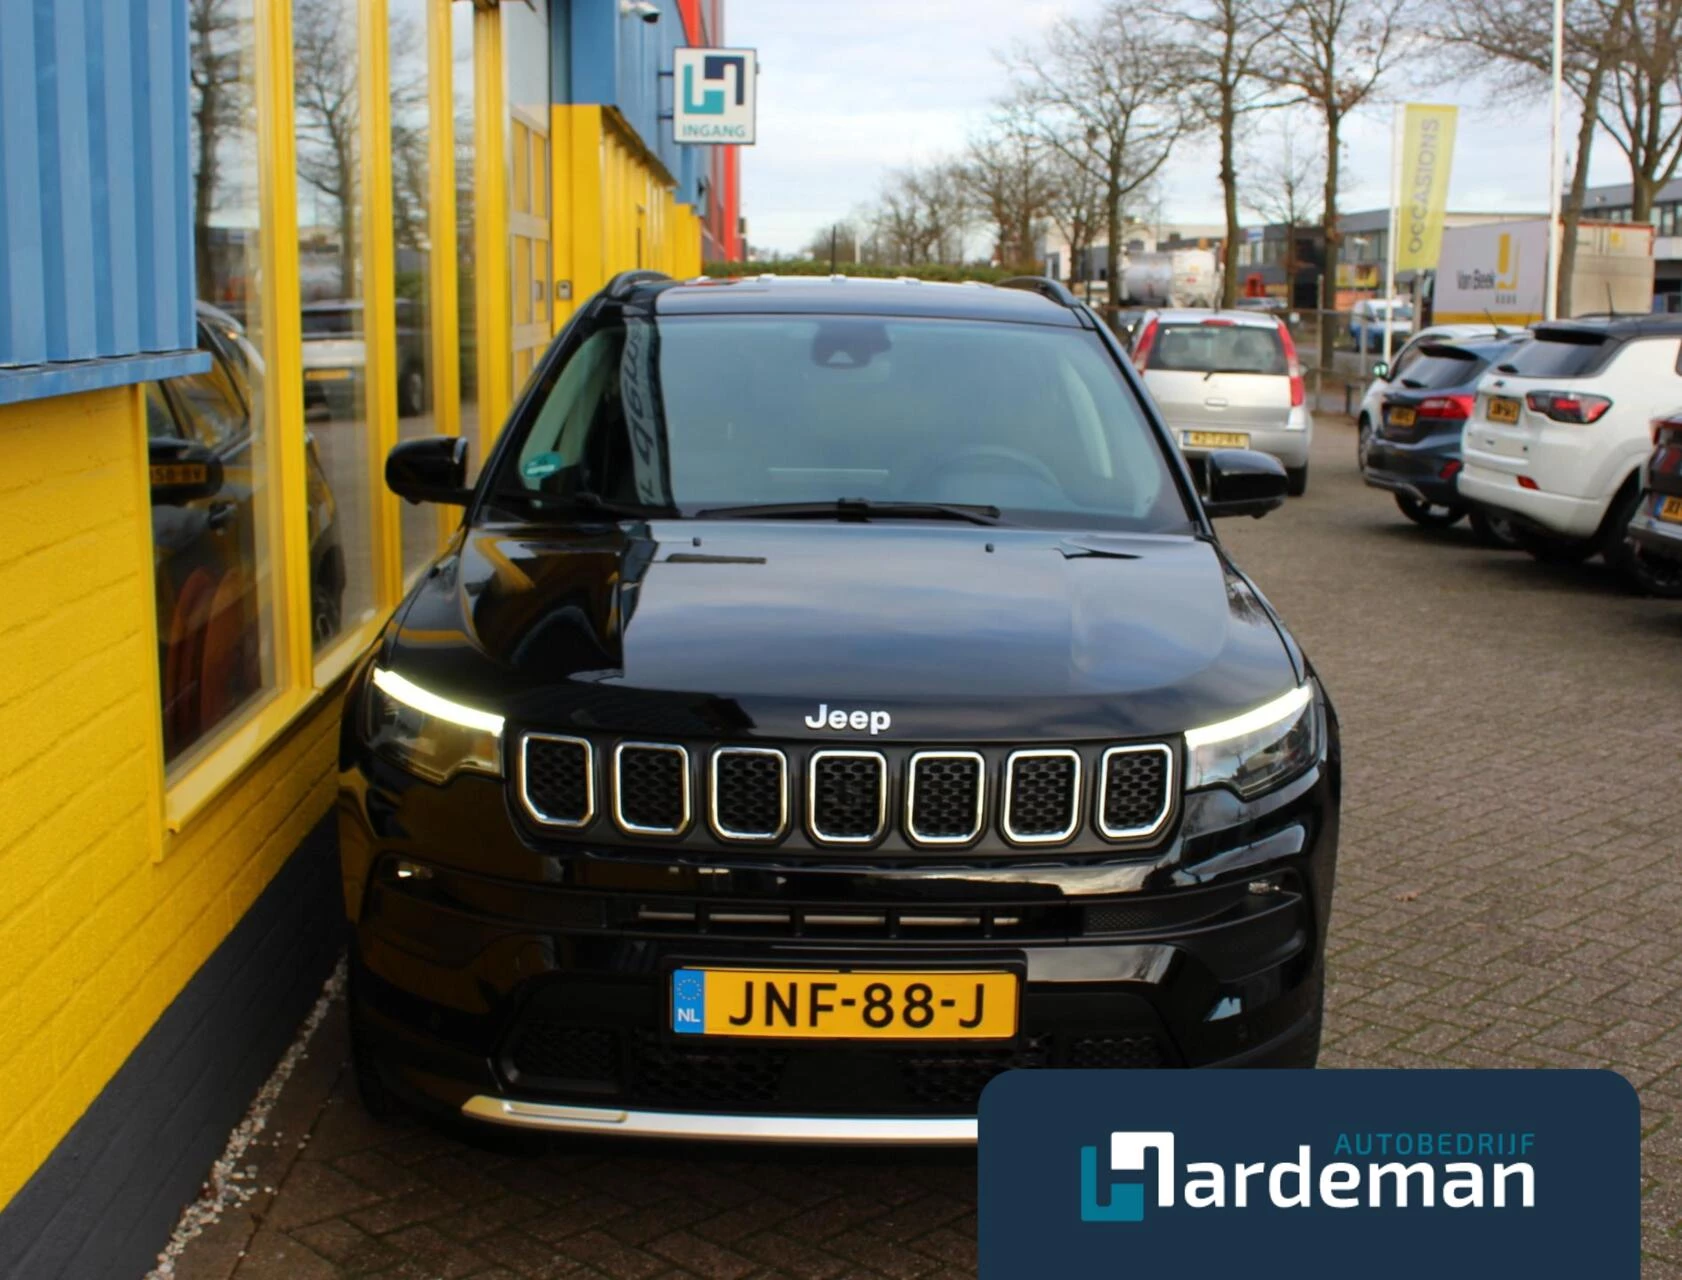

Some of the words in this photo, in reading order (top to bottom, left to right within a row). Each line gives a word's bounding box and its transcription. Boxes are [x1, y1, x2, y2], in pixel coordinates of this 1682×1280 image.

[683, 124, 746, 137] INGANG
[1408, 118, 1440, 253] OCCASIONS
[805, 703, 891, 735] Jeep
[677, 1008, 701, 1023] NL
[729, 981, 985, 1029] JNF-88-J
